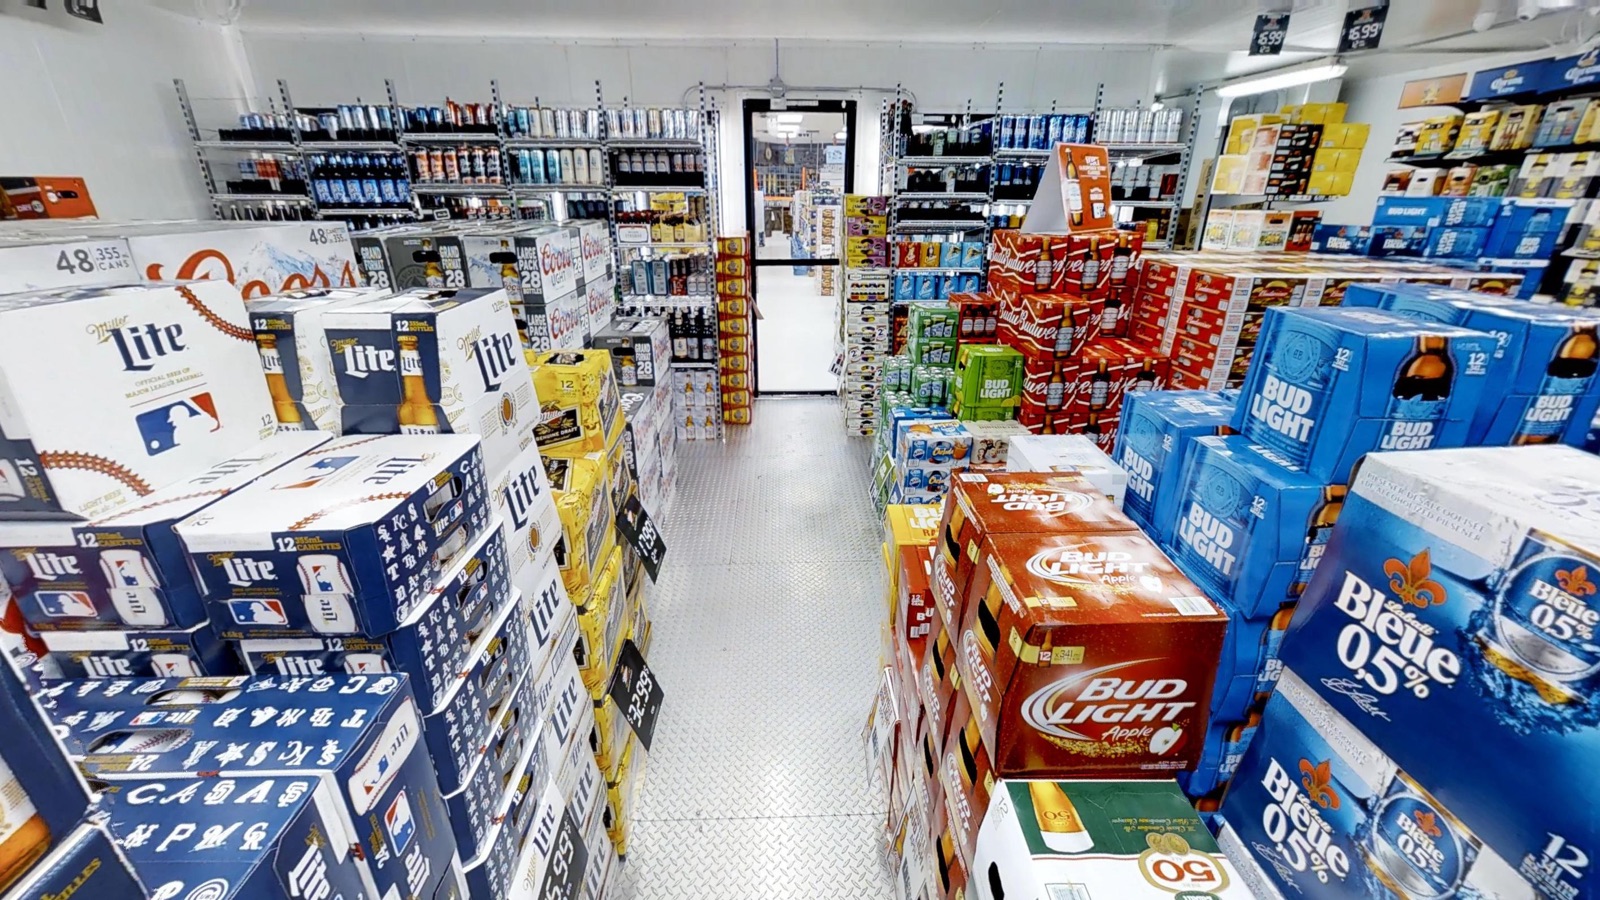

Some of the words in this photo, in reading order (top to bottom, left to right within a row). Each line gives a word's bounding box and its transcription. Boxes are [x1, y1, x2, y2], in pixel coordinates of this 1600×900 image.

[1404, 206, 1428, 215] LIGHT
[309, 228, 328, 245] 48
[360, 246, 382, 259] GRAND
[438, 246, 460, 258] GRAND
[516, 246, 538, 259] LARGE
[541, 242, 573, 276] Coors
[57, 248, 94, 274] 48
[98, 259, 130, 271] CANS
[519, 259, 539, 271] PACK
[369, 271, 389, 288] 28
[445, 270, 466, 288] 28
[521, 271, 542, 288] 28
[253, 319, 267, 331] 12
[395, 320, 409, 331] 12
[526, 313, 547, 325] LARGE
[86, 315, 129, 344] Miller
[529, 325, 549, 337] PACK
[106, 323, 187, 372] Lite
[531, 337, 550, 351] 28
[261, 354, 282, 369] Lite
[345, 345, 396, 378] Lite
[401, 355, 422, 369] Lite
[474, 330, 518, 392] Lite
[1335, 348, 1349, 360] 12
[1469, 353, 1485, 365] 12
[637, 361, 653, 375] 28
[561, 380, 573, 389] 12
[985, 379, 1009, 389] BUD
[979, 388, 1012, 399] LIGHT
[1263, 374, 1313, 415] BUD
[1534, 394, 1573, 409] BUD
[1251, 393, 1315, 443] LIGHT
[1526, 407, 1573, 422] LIGHT
[560, 426, 578, 435] DRAFT
[1391, 421, 1434, 436] BUD
[1382, 435, 1435, 450] LIGHT
[14, 458, 31, 476] 12
[1124, 445, 1154, 481] BUD
[426, 481, 437, 495] 12
[1119, 458, 1154, 502] LIGHT
[504, 465, 540, 532] Lite
[1003, 501, 1066, 511] BUD
[1252, 495, 1266, 508] 12
[434, 516, 449, 537] Lite
[1188, 502, 1234, 549] BUD
[77, 533, 98, 548] 12
[276, 537, 296, 552] 12
[297, 542, 341, 550] CANETTES
[1179, 516, 1236, 577] LIGHT
[1060, 552, 1132, 562] BUD
[25, 553, 82, 581] Lite
[222, 557, 279, 587] Lite
[1050, 562, 1149, 575] LIGHT
[1101, 573, 1136, 584] Apple
[320, 599, 338, 622] Lite
[1528, 579, 1600, 626] Bleue
[528, 578, 560, 650] Lite
[1384, 599, 1440, 636] Labatt
[1531, 602, 1594, 640] 0,5%
[1334, 571, 1461, 684] Bleue
[130, 638, 149, 651] 12
[326, 638, 344, 652] 12
[1039, 651, 1051, 661] 12
[1337, 624, 1430, 699] 0,5%
[82, 656, 135, 678] Lite
[275, 656, 327, 676] Lite
[971, 642, 992, 688] BUD
[966, 646, 992, 703] LIGHT
[1076, 678, 1188, 701] BUD
[551, 676, 579, 749] Lite
[1046, 702, 1197, 724] LIGHT
[1102, 725, 1153, 741] Apple
[568, 762, 594, 830] Lite
[1043, 810, 1071, 821] 50
[1261, 757, 1350, 881] Bleue
[1297, 793, 1335, 834] Labatt
[532, 803, 556, 860] Lite
[1397, 813, 1445, 862] Bleue
[1262, 802, 1329, 885] 0,5%
[1542, 832, 1589, 879] 12
[1152, 859, 1216, 882] 50
